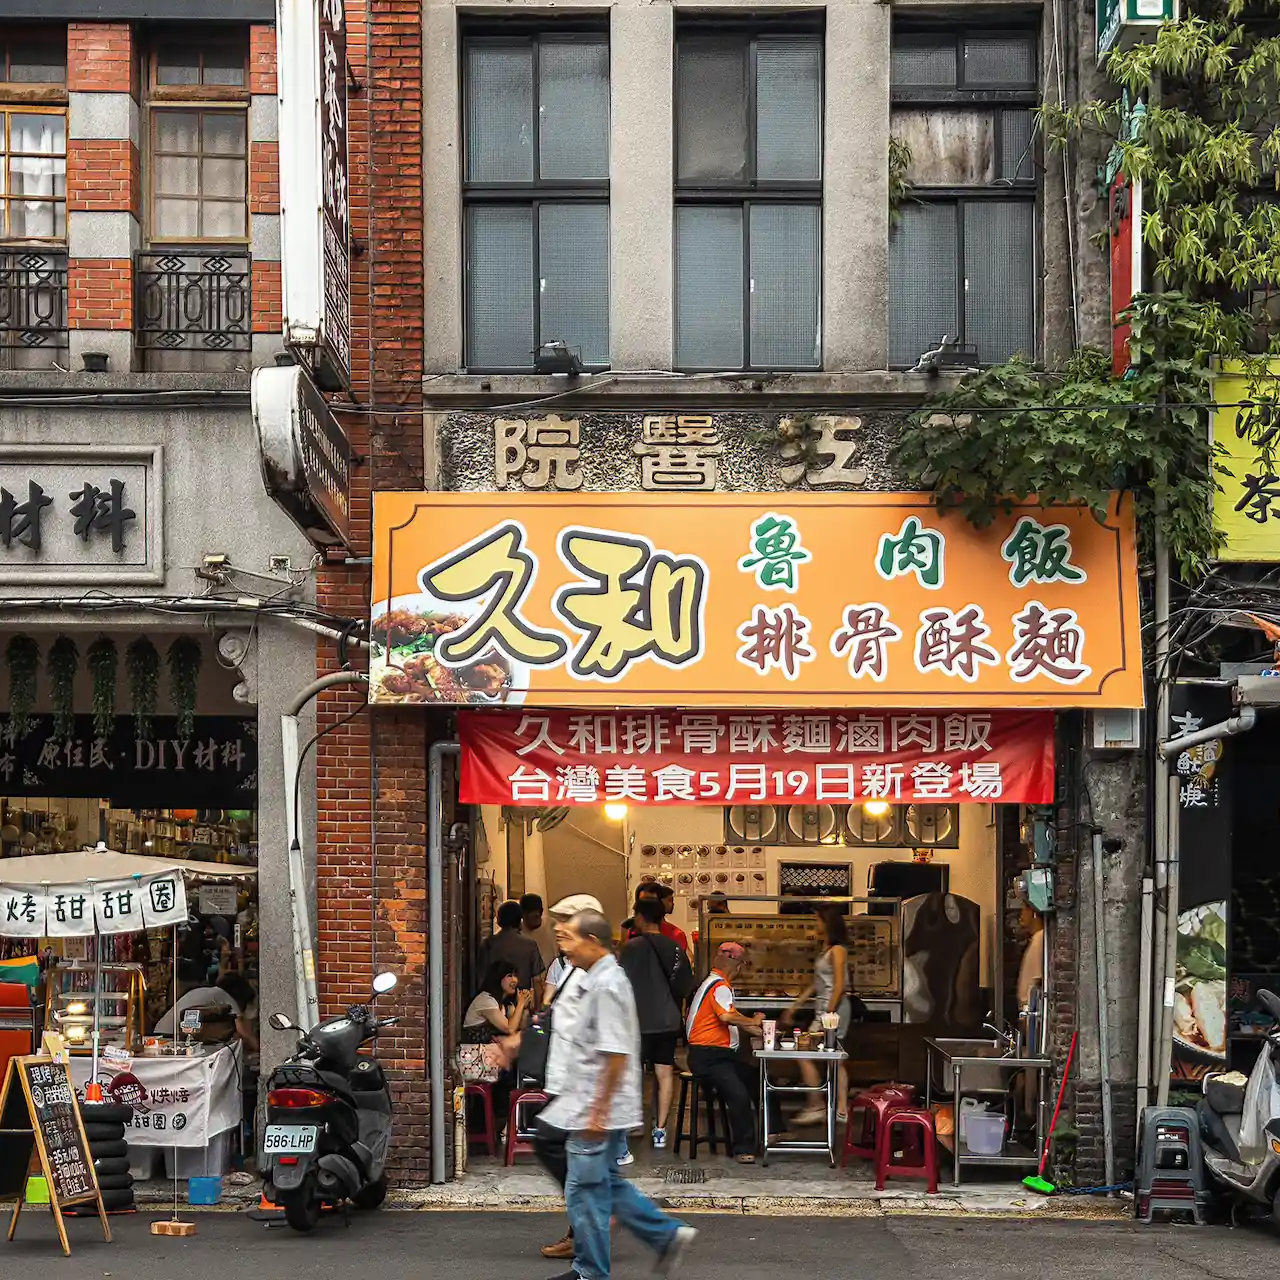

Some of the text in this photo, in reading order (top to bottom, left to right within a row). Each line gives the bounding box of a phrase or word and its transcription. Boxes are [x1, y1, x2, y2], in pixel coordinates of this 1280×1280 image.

[742, 515, 1086, 588] 魯肉飯
[423, 522, 708, 677] 久和
[742, 604, 1088, 681] 排骨酥麵
[514, 714, 993, 756] 久和排骨酥麵滷肉飯
[509, 762, 1003, 803] 台灣美食5月19日新登場
